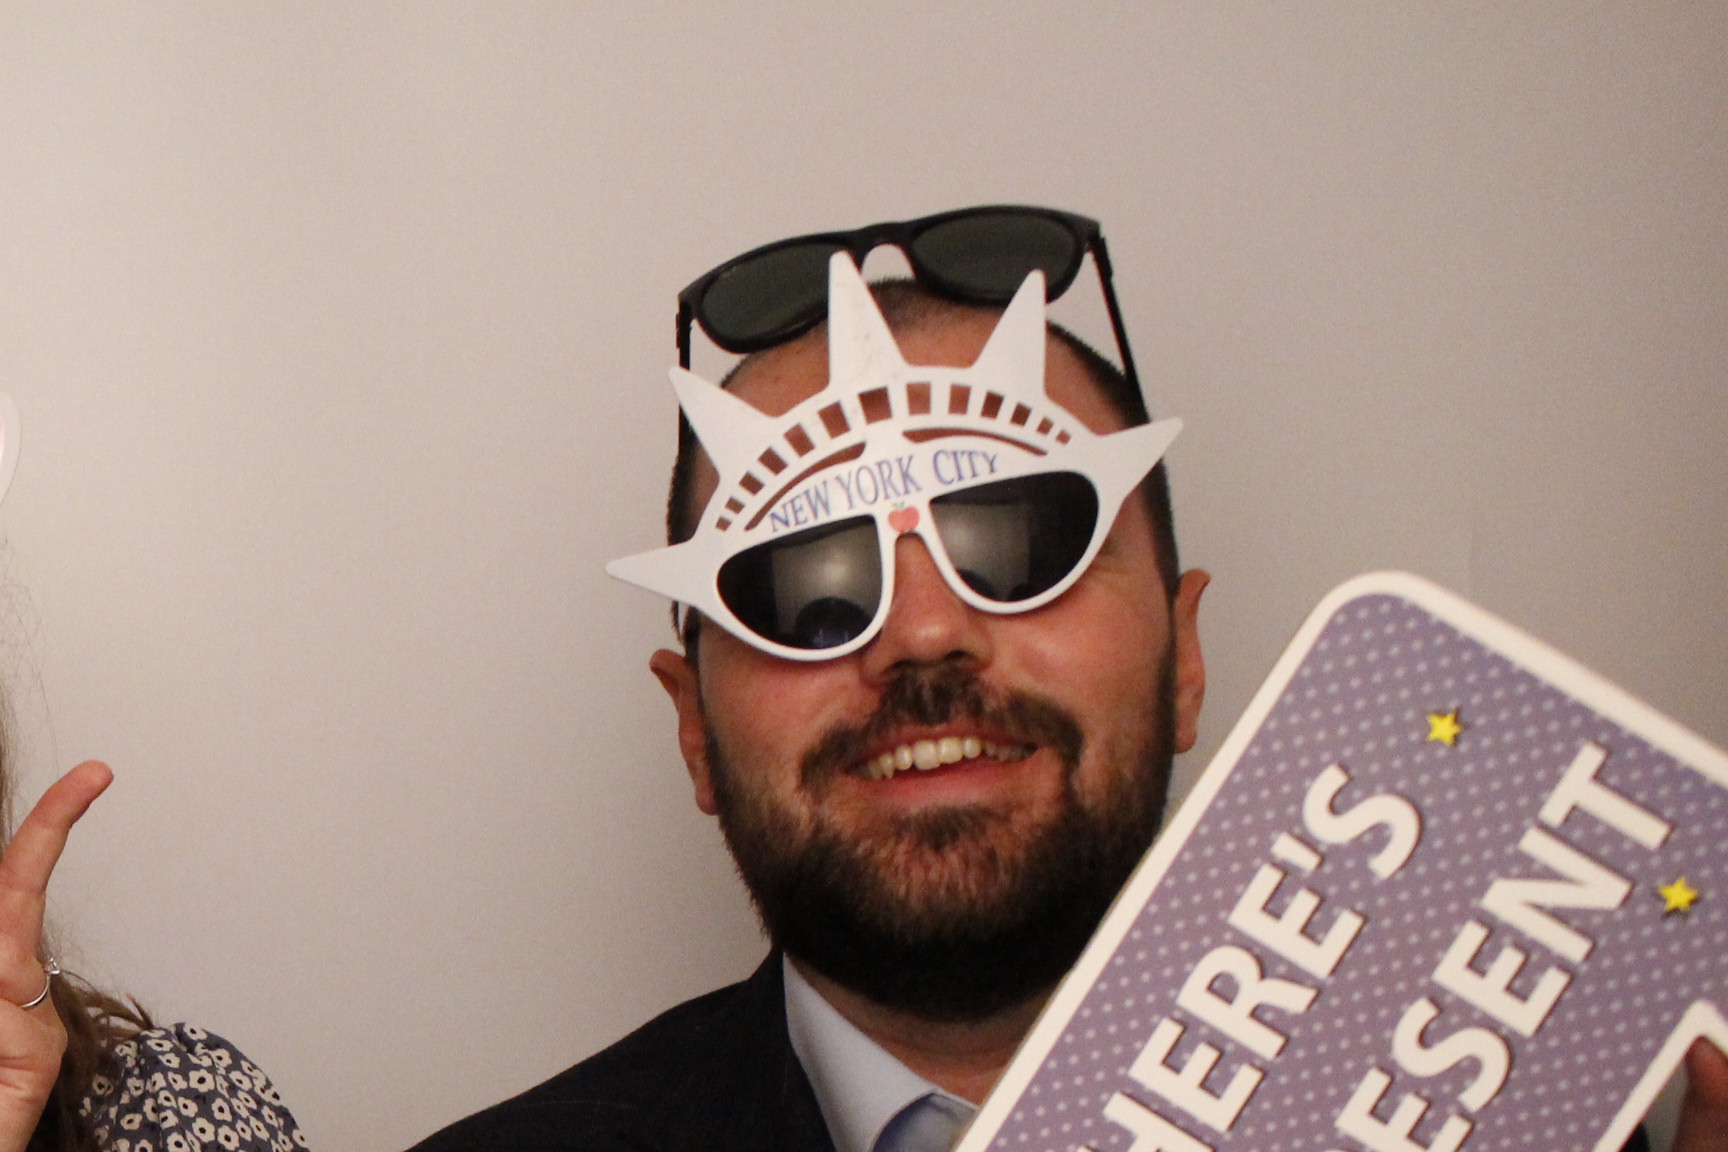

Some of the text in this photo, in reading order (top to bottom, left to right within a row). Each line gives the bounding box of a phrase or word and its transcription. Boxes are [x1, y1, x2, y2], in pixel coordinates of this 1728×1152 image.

[768, 449, 998, 534] NEW YORK CITY
